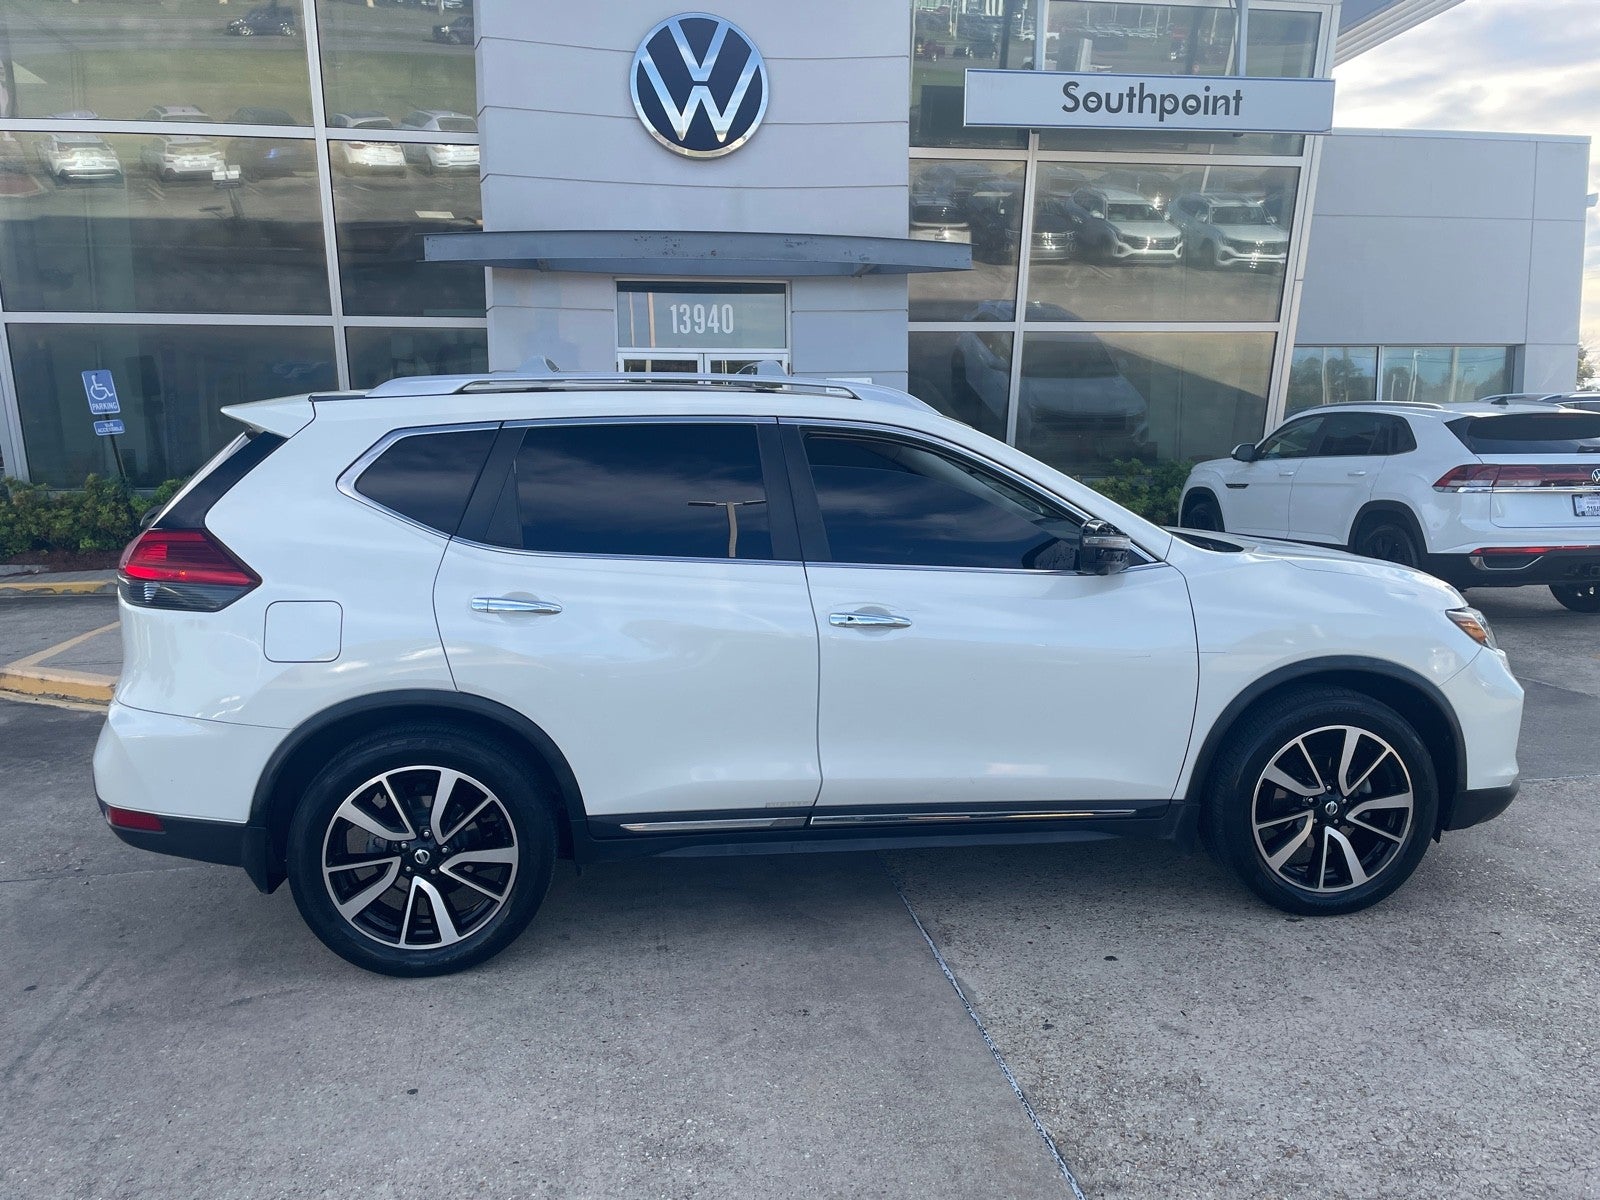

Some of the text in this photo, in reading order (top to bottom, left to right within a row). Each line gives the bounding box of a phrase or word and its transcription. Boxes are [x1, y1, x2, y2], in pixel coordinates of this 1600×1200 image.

[634, 16, 766, 146] VW
[1062, 81, 1243, 122] Southpoint
[669, 304, 734, 334] 13940
[92, 402, 118, 411] PARKING
